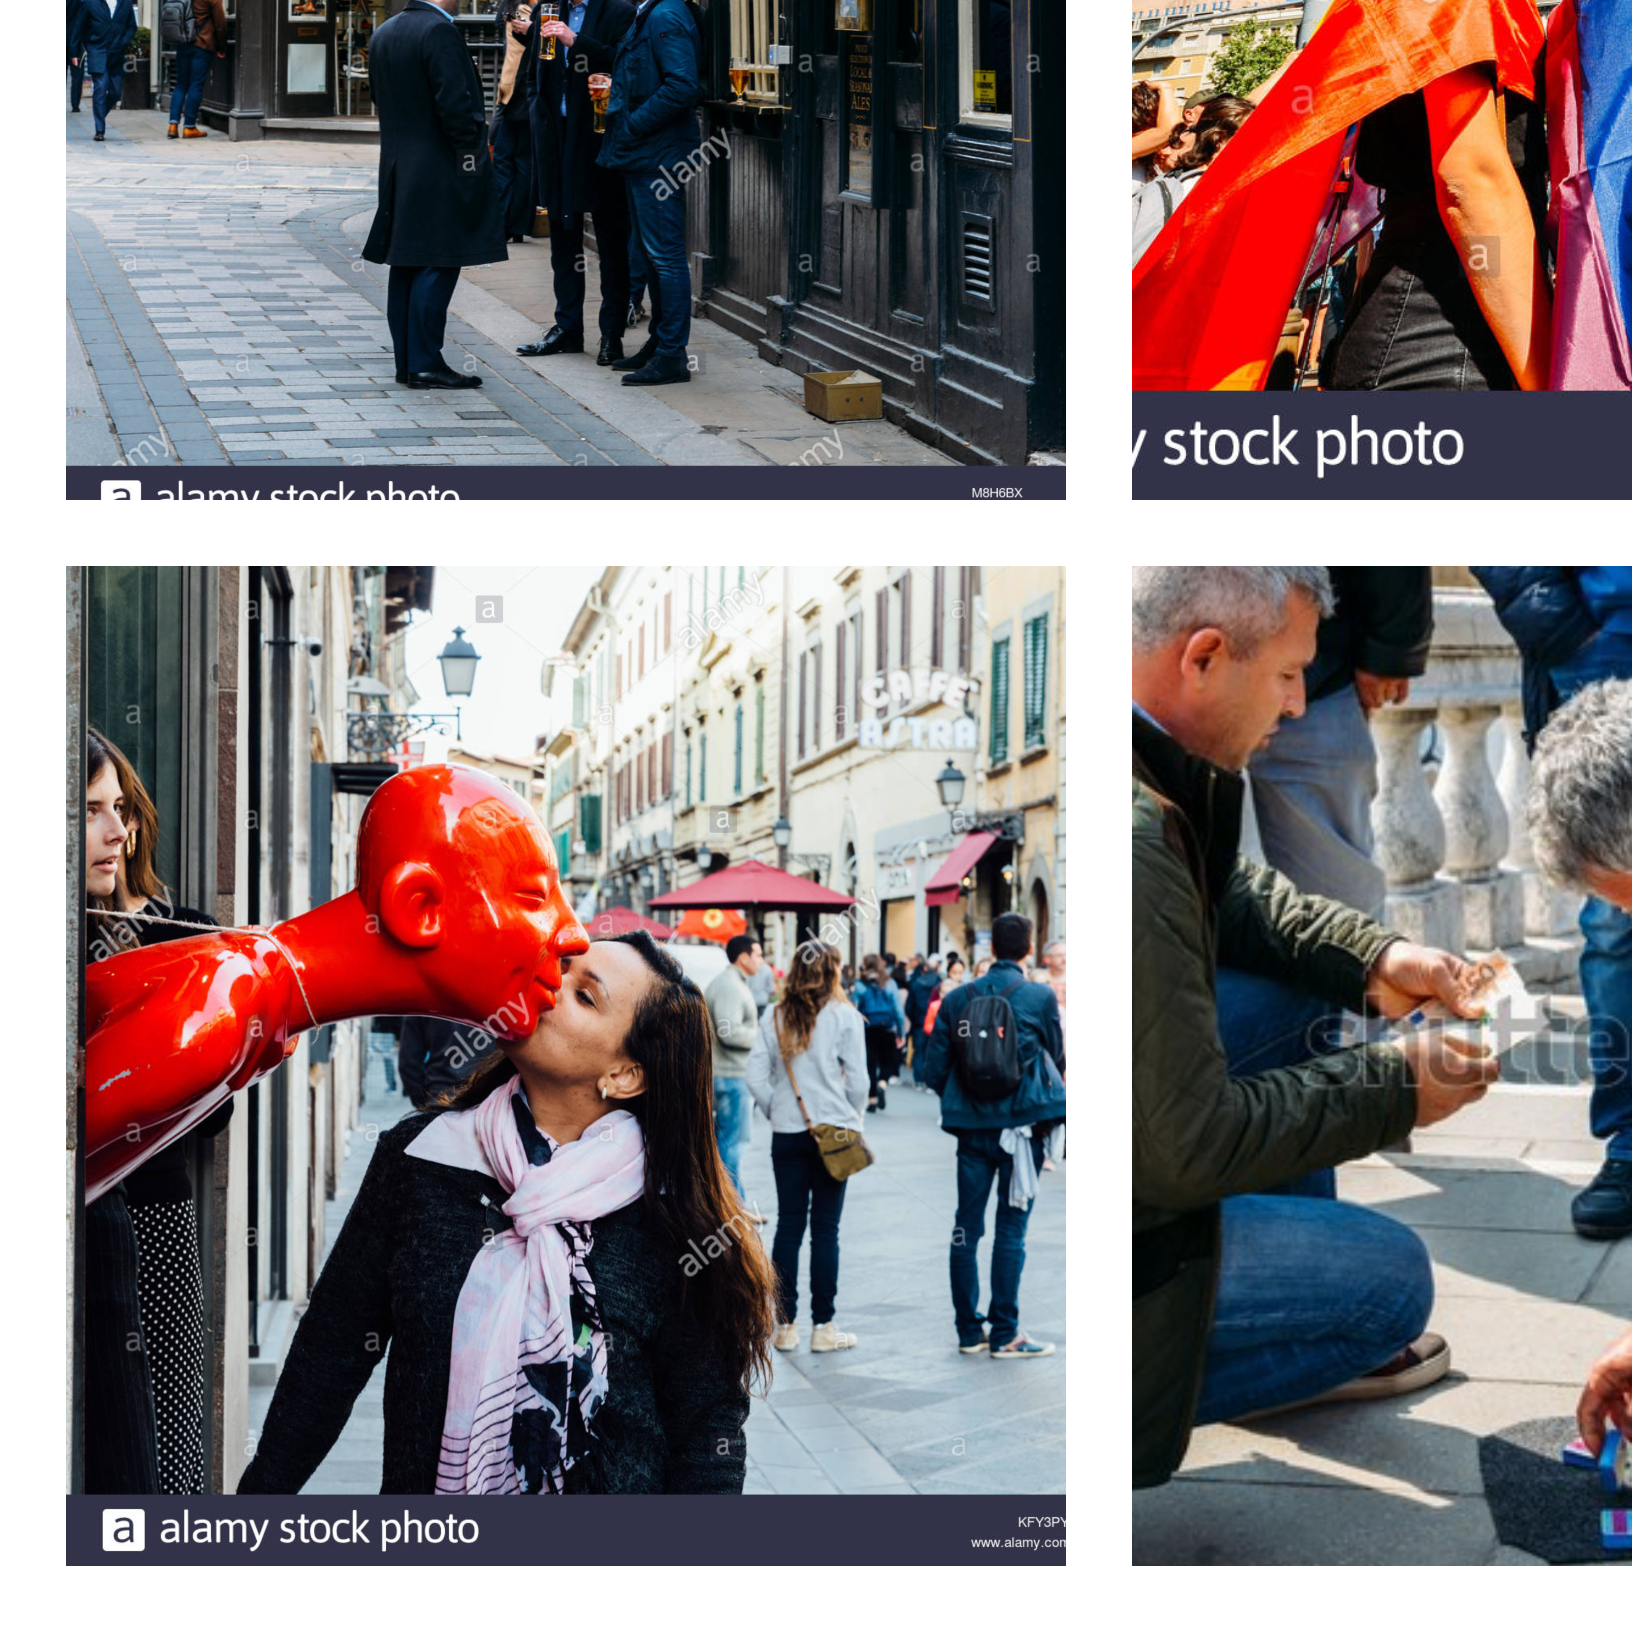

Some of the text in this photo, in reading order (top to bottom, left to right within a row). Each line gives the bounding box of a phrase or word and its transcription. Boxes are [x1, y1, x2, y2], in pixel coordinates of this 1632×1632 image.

[850, 65, 868, 79] LOCAL
[851, 93, 871, 111] ALES
[858, 717, 979, 750] ASTRA
